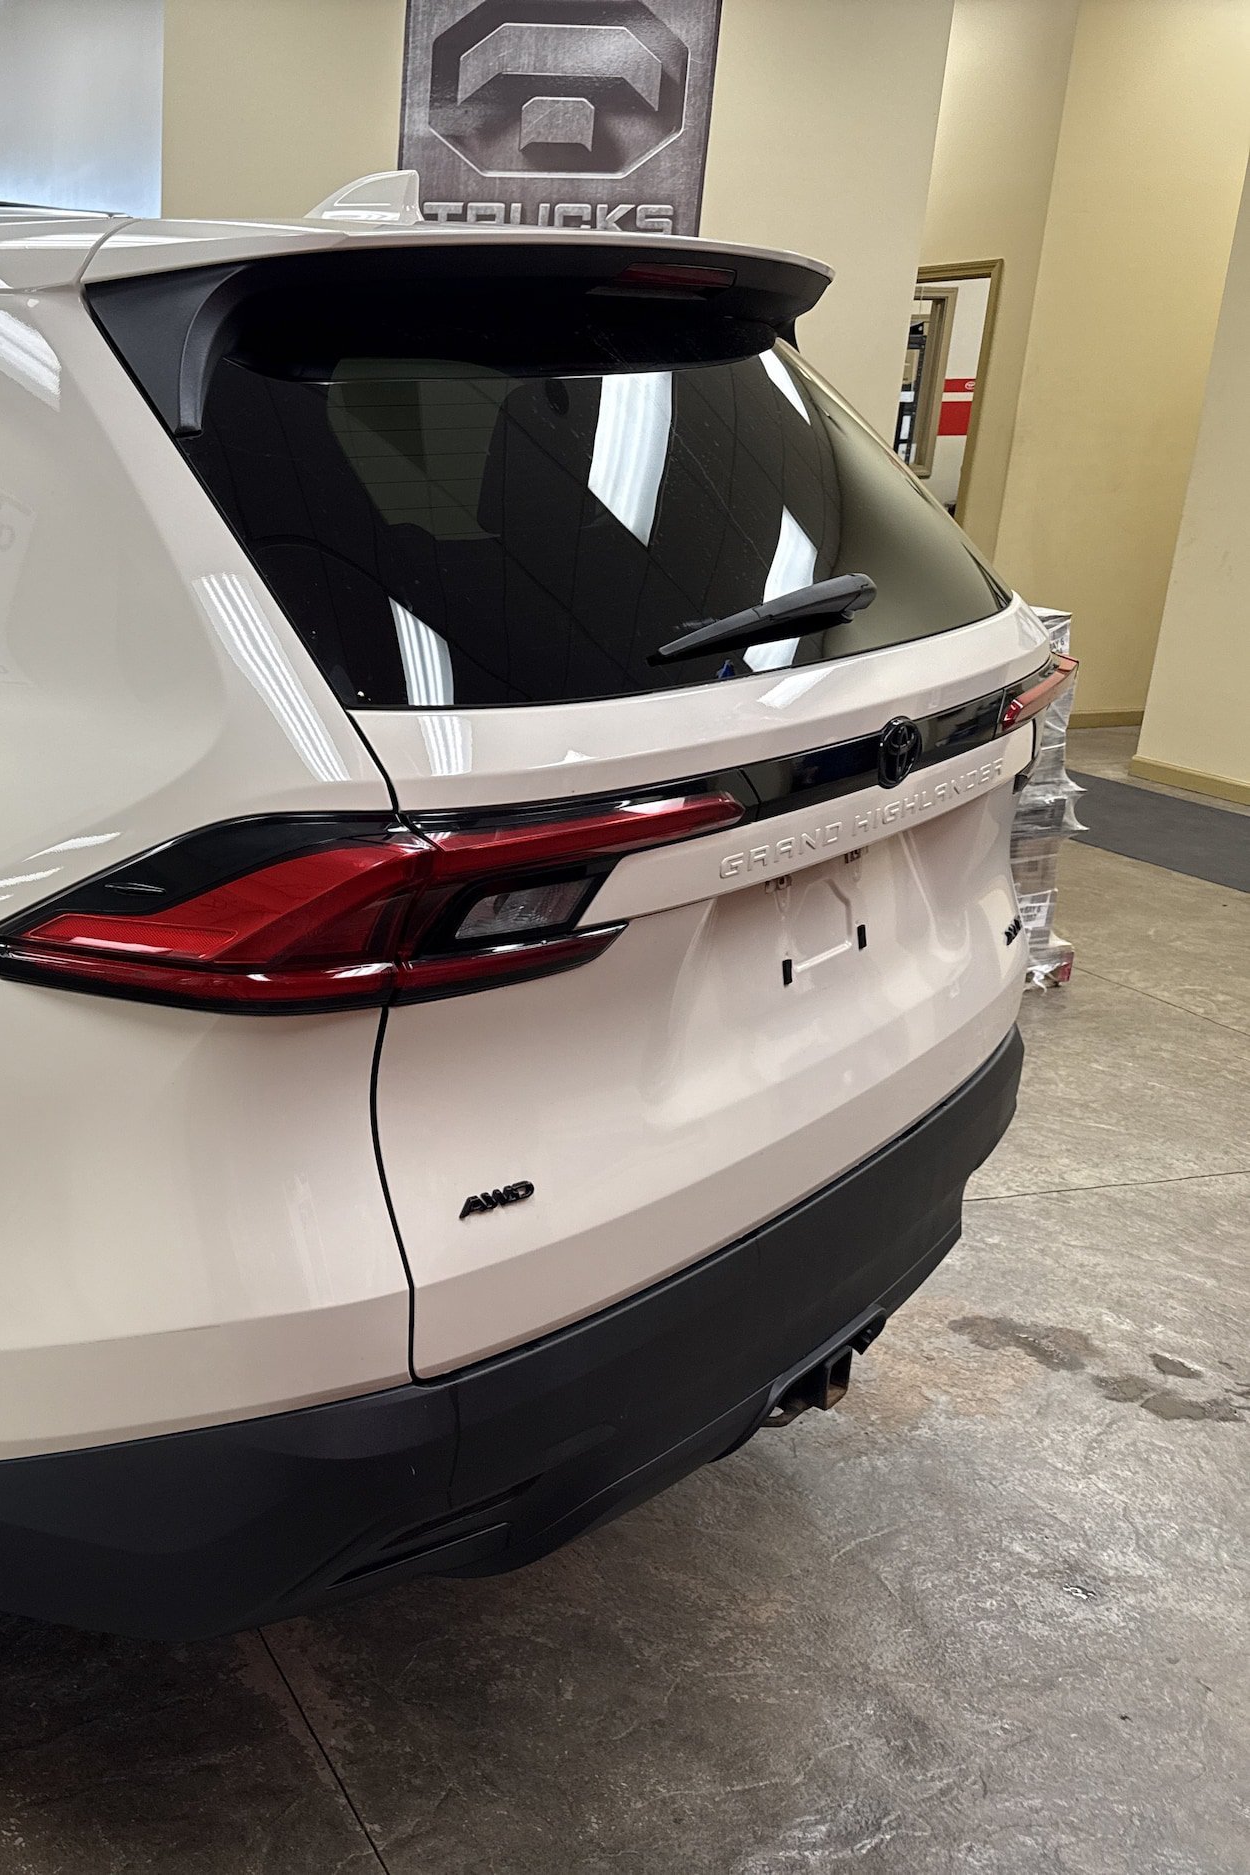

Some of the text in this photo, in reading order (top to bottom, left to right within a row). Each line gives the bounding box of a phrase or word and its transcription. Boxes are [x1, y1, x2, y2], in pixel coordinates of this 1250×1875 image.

[719, 757, 1004, 879] GRAND HIGHLANDER
[458, 1180, 535, 1220] AWD
